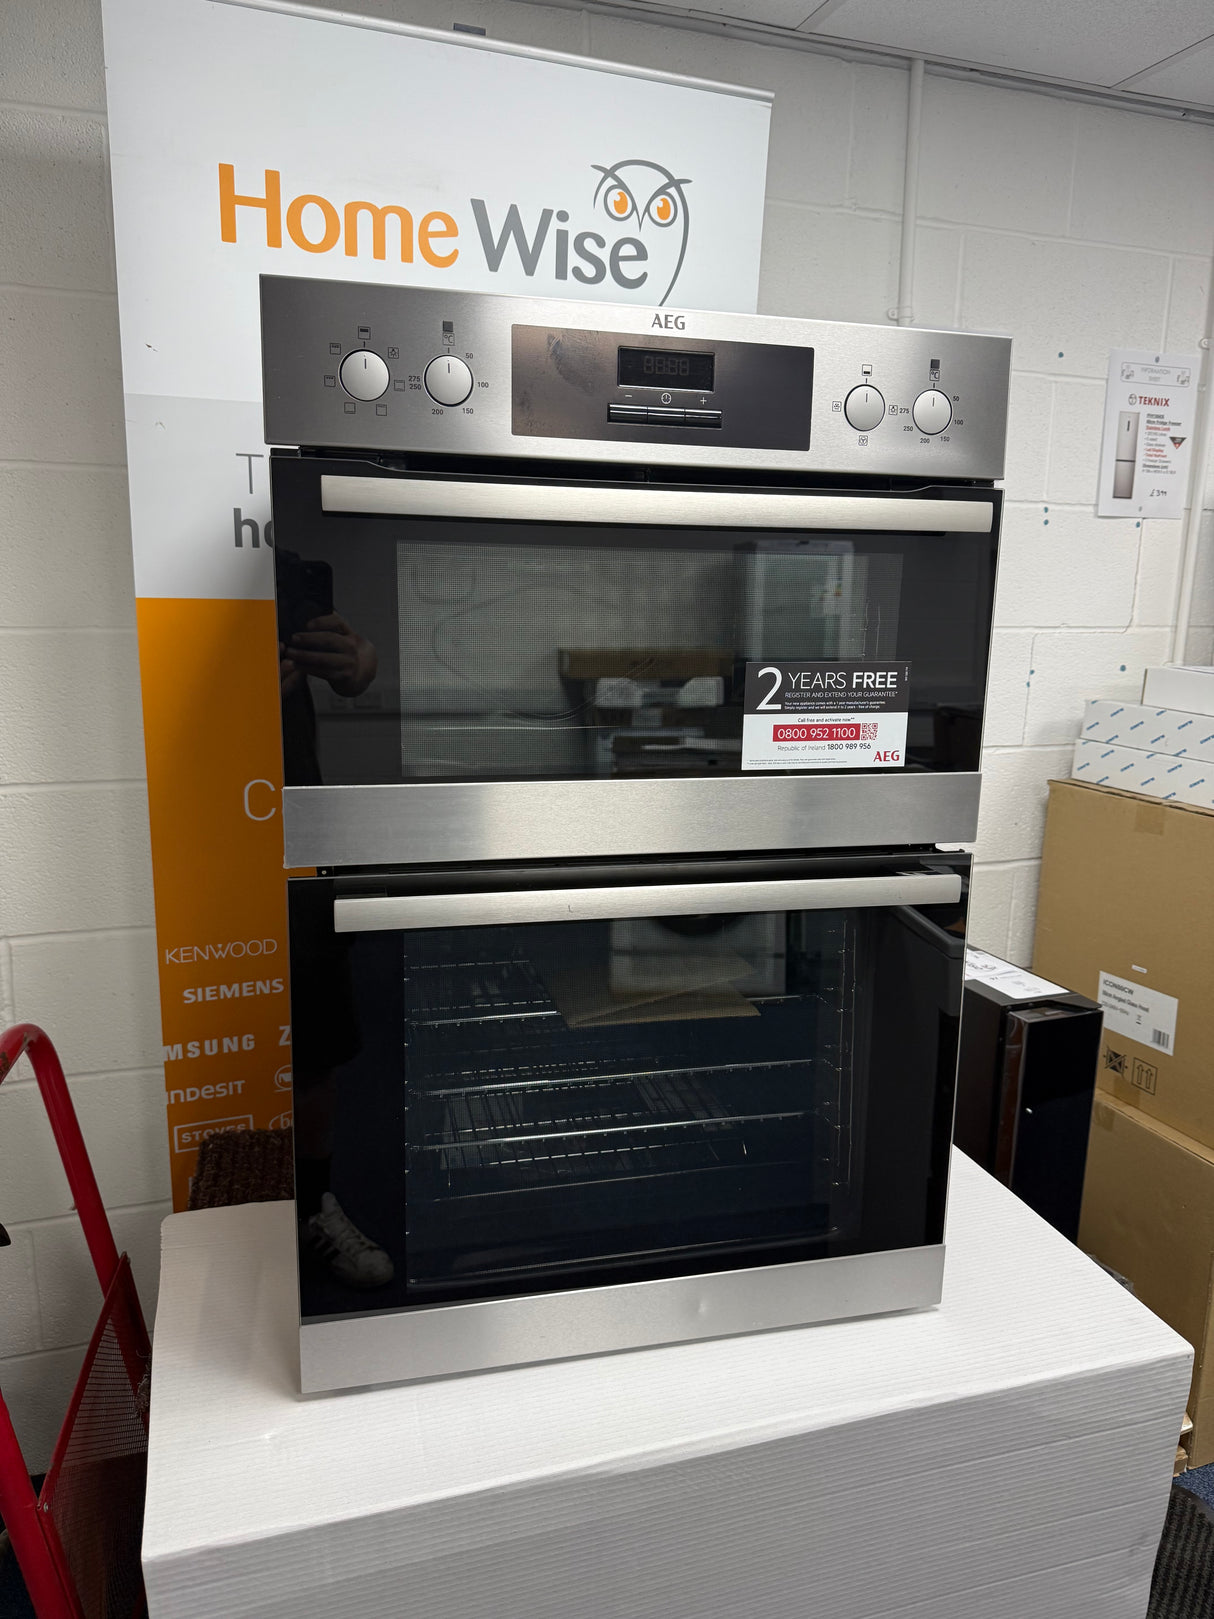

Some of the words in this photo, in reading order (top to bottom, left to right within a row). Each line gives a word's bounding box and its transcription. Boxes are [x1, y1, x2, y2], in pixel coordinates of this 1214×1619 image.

[218, 162, 459, 269] Home
[470, 197, 649, 290] Wise
[651, 313, 686, 330] AEG
[1138, 396, 1170, 407] TEKNIX
[756, 666, 783, 711] 2
[788, 672, 847, 689] YEARS
[852, 671, 898, 689] FREE
[777, 728, 807, 739] 0800
[811, 727, 829, 739] 952
[832, 727, 856, 738] 1100
[777, 744, 799, 752] Republic
[873, 750, 900, 762] AEG
[165, 938, 278, 965] KENWOOD
[182, 978, 285, 1004] SIEMENS
